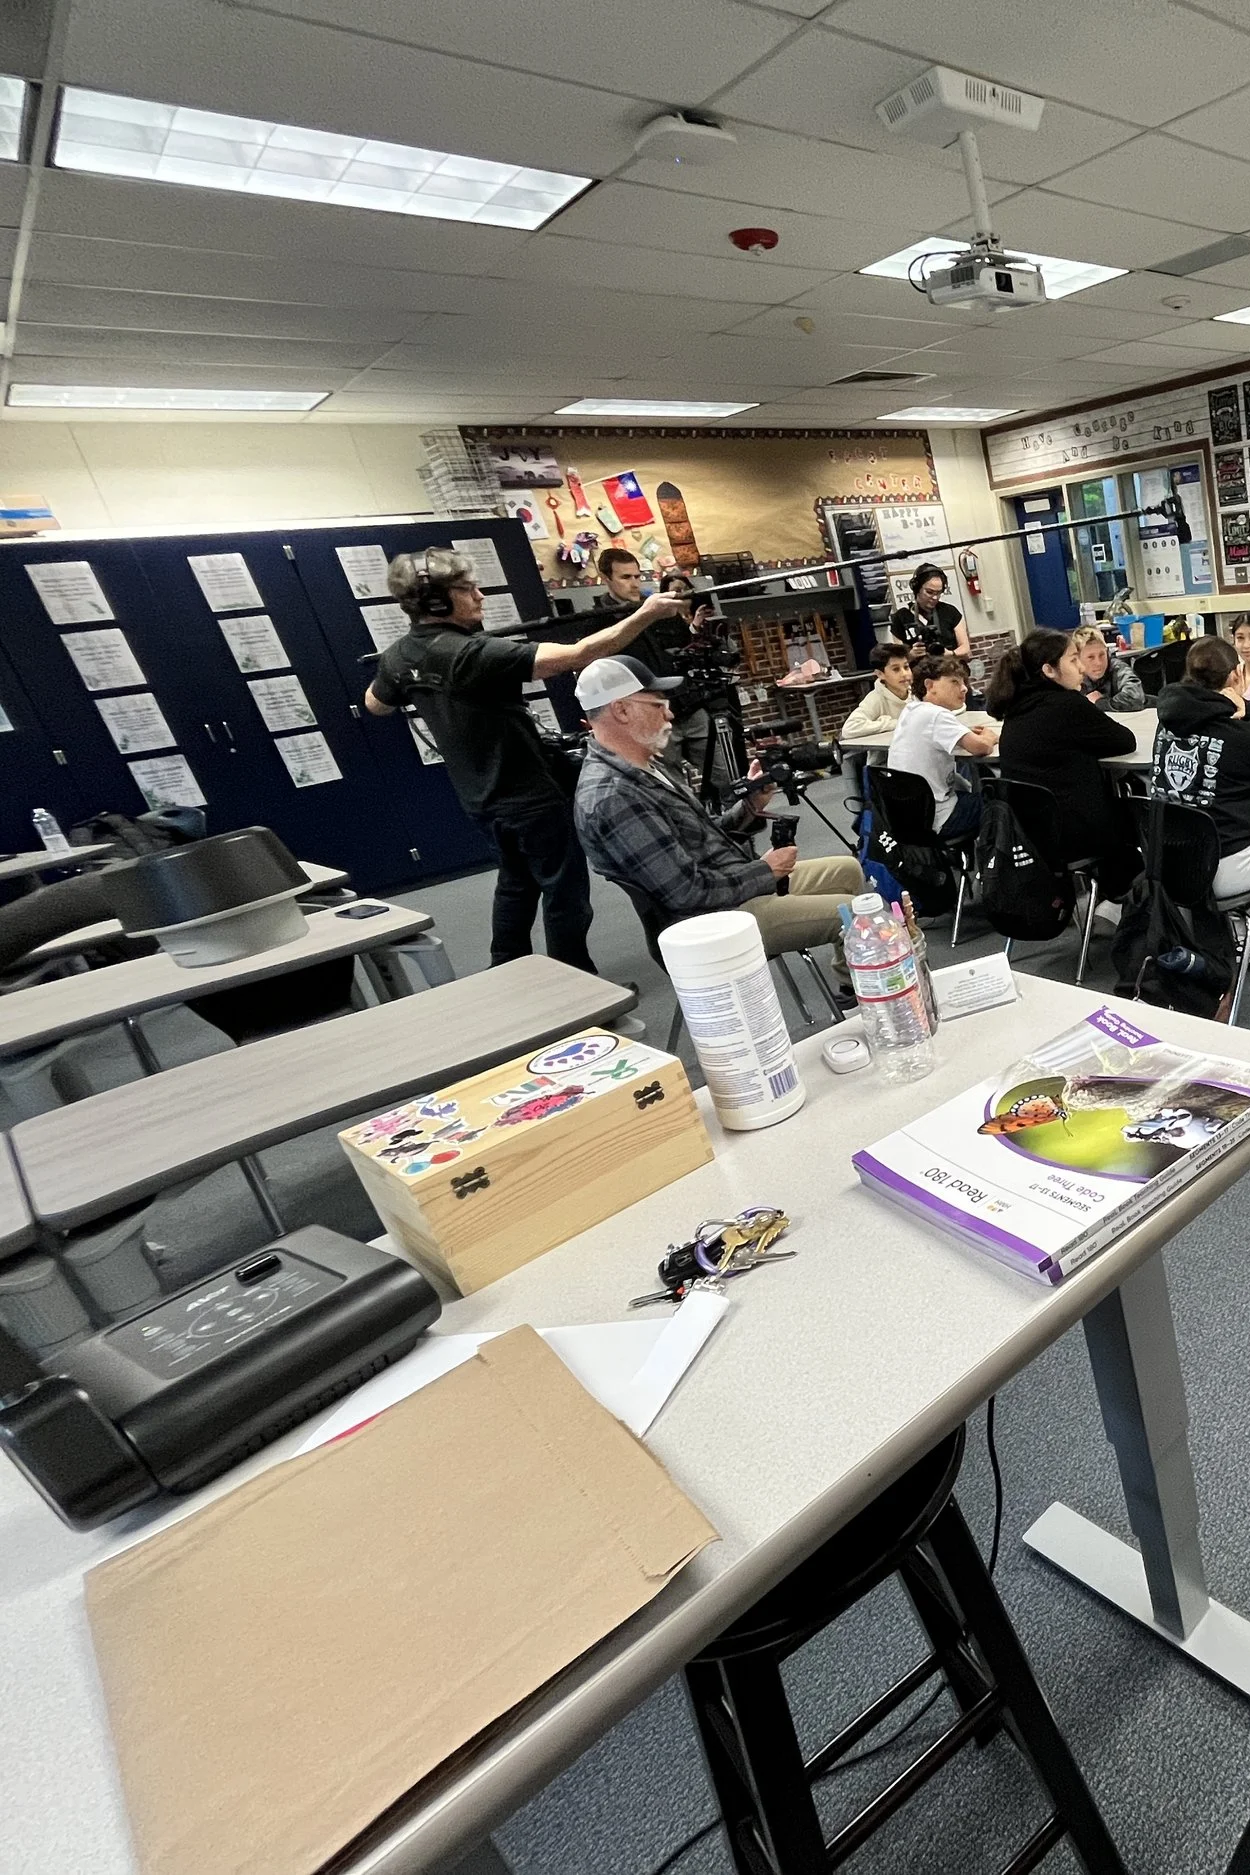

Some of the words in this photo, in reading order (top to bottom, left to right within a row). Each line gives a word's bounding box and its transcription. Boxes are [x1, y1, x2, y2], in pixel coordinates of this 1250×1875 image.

[1062, 445, 1089, 464] And
[1153, 420, 1195, 441] Kind
[882, 507, 919, 520] HAPPY
[1168, 755, 1196, 770] RUGBY
[1096, 1016, 1116, 1033] Book
[923, 1167, 953, 1185] 180
[1047, 1173, 1076, 1191] Three
[944, 1179, 989, 1204] Read
[1060, 1239, 1075, 1255] Read
[1074, 1230, 1089, 1243] 180
[1158, 1167, 1176, 1182] Guide
[1231, 1117, 1245, 1129] Code
[1076, 1185, 1105, 1204] Code
[1049, 1190, 1091, 1213] SEGMENTS
[1070, 1249, 1087, 1265] Read
[1086, 1241, 1098, 1254] 180
[1166, 1178, 1183, 1195] Guide
